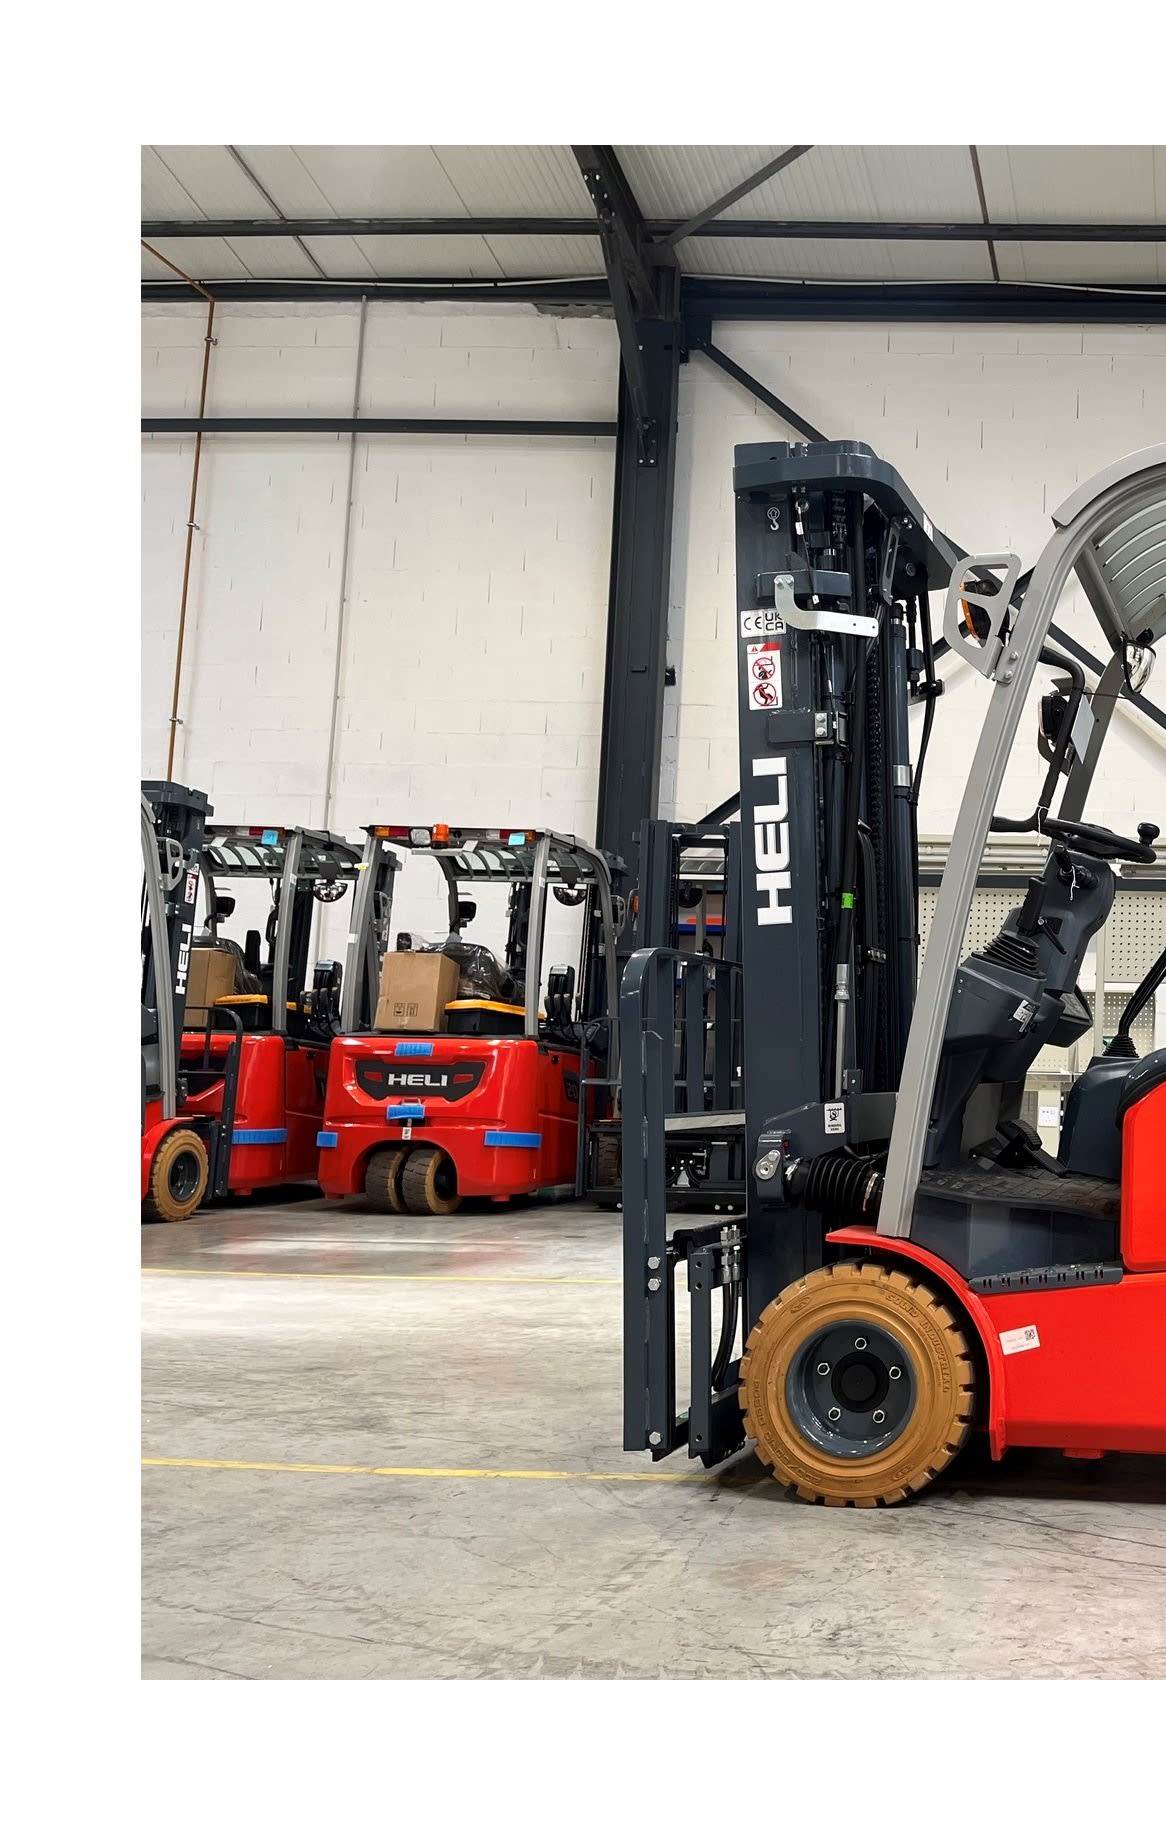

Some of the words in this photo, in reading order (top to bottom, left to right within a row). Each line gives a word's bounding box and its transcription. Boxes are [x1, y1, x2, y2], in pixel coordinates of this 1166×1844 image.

[766, 621, 784, 631] CA
[752, 756, 793, 926] HELI
[175, 923, 193, 995] HELI
[388, 1073, 448, 1087] HELI
